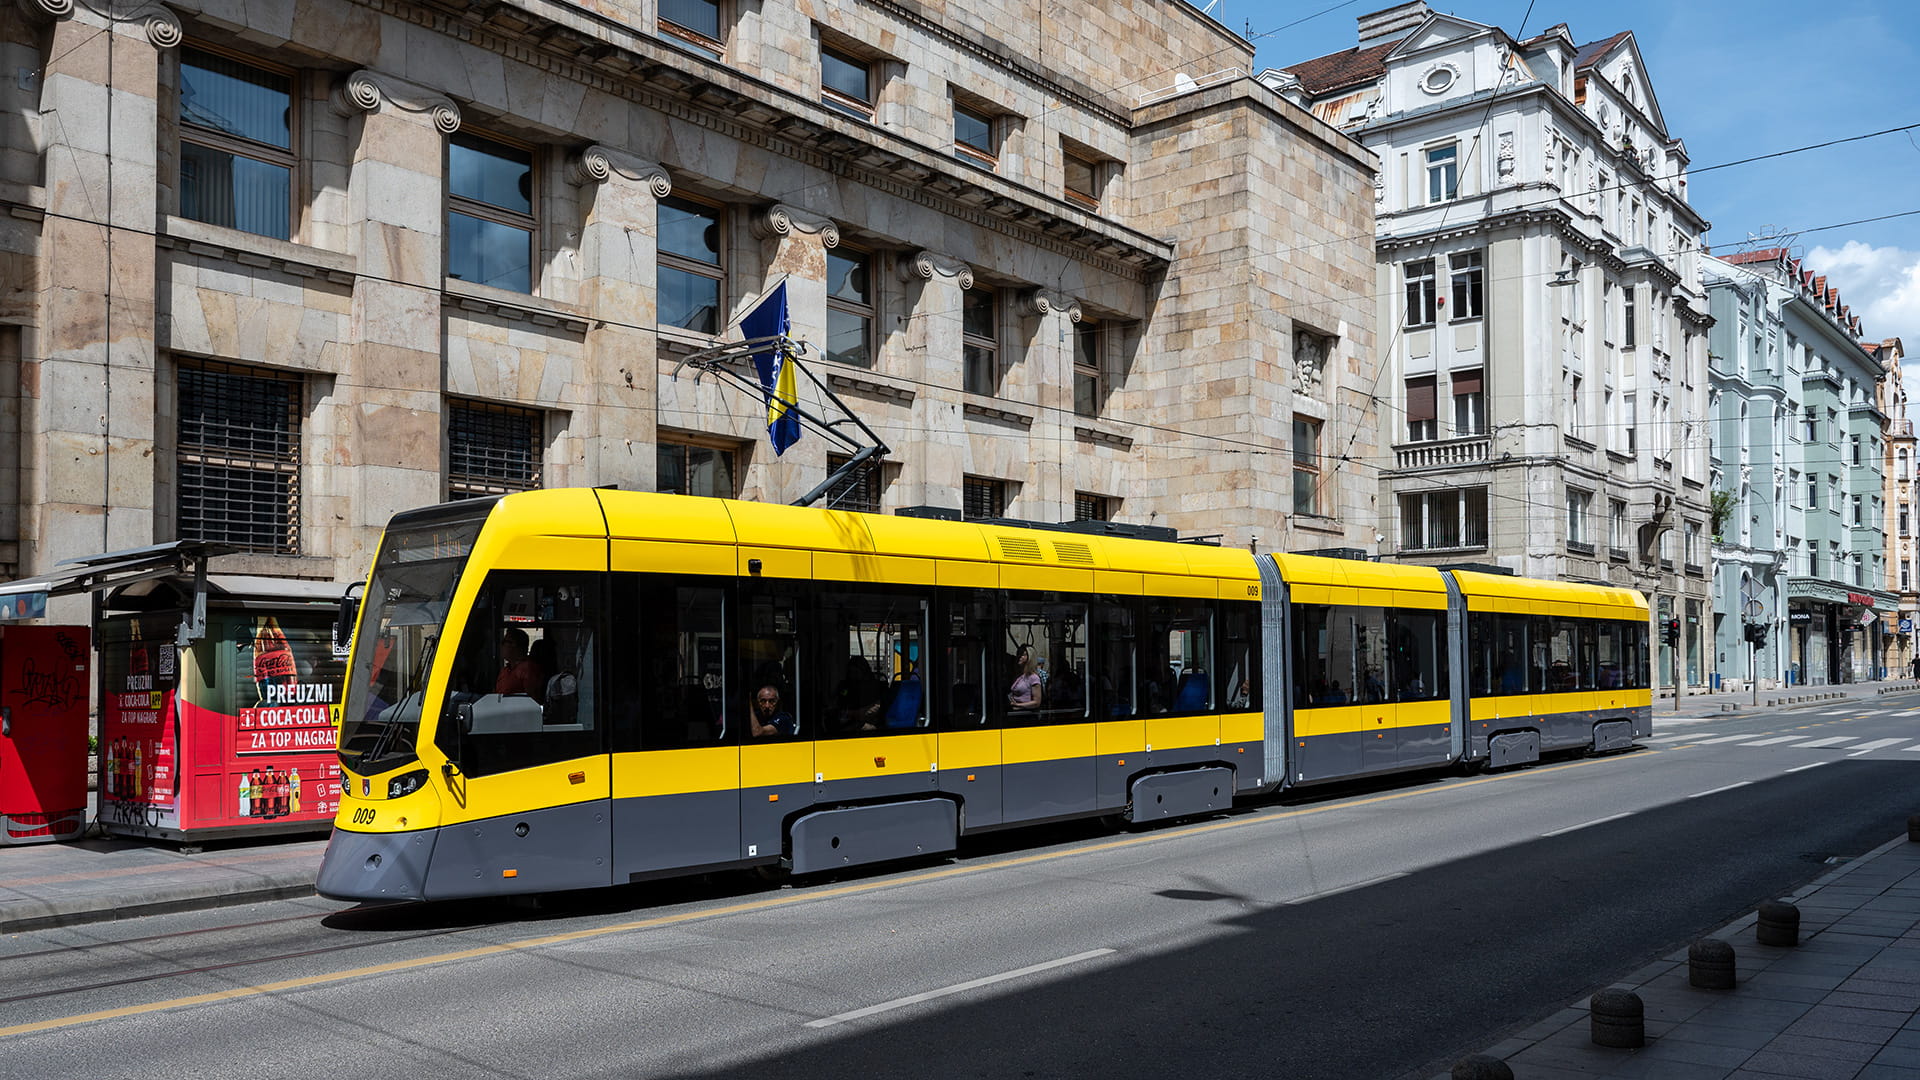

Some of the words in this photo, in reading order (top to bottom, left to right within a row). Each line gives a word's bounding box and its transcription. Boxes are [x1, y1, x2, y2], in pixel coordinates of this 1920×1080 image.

[1247, 585, 1258, 596] 009
[127, 675, 153, 690] PREUZMI
[125, 694, 150, 707] COCA-COLA
[266, 683, 333, 704] PREUZMI
[137, 711, 158, 724] NAGRADE
[260, 707, 326, 727] COCA-COLA
[251, 732, 266, 748] ZA
[269, 732, 292, 747] TOP
[352, 807, 376, 825] 009
